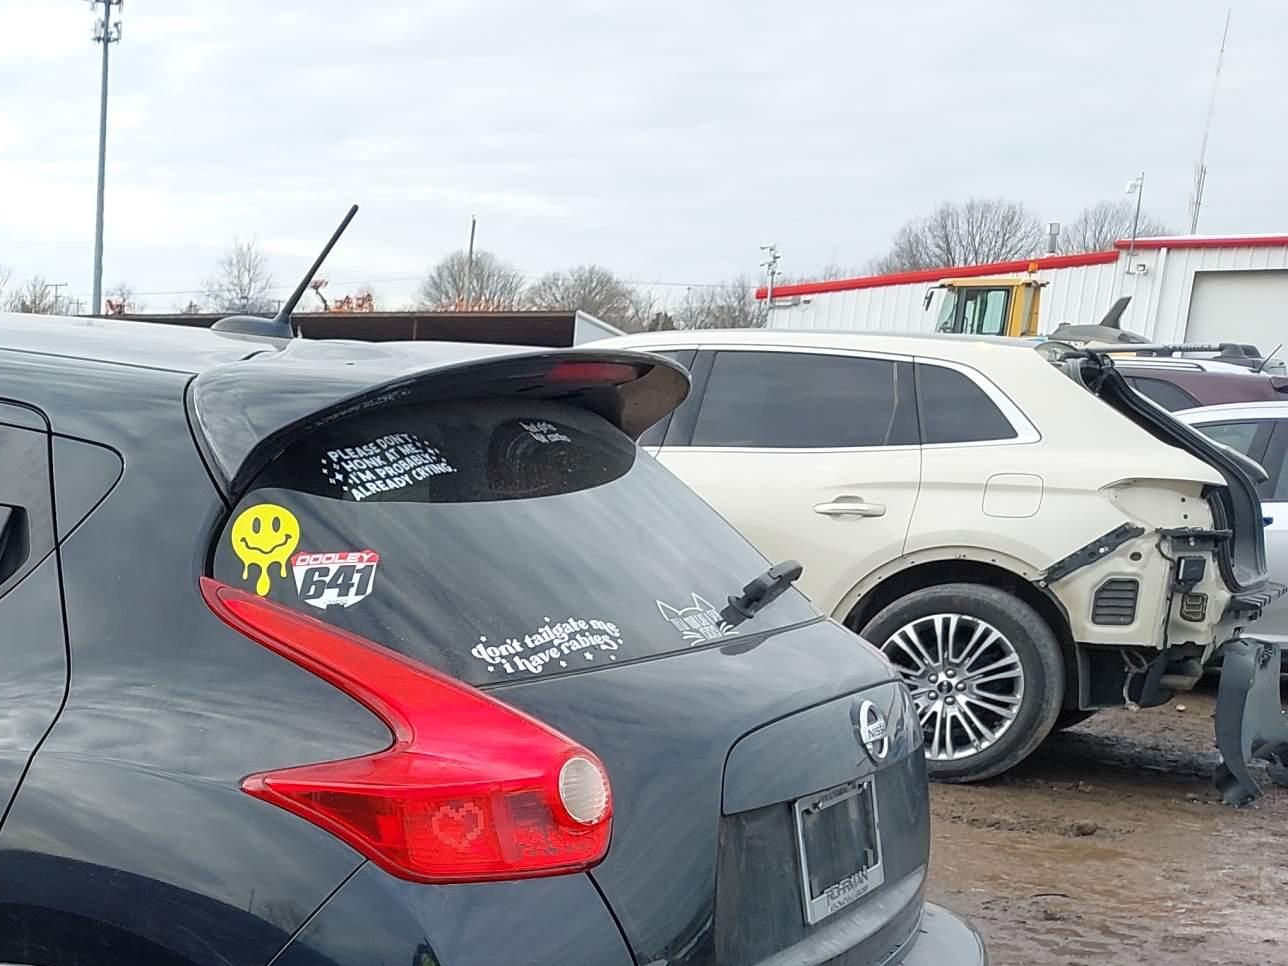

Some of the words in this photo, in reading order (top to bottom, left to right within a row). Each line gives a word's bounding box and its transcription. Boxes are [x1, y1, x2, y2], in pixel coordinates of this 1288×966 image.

[327, 442, 381, 462] PLEASE
[376, 433, 413, 450] DON'T
[340, 455, 387, 472] HONK
[384, 448, 400, 462] AT
[348, 470, 377, 484] I'M
[374, 452, 434, 478] PROBABLY
[351, 474, 414, 501] ALREADY
[296, 552, 373, 566] DOOLEY
[298, 564, 375, 600] 641
[471, 638, 524, 664] don't
[524, 617, 589, 647] tailgate
[589, 619, 620, 637] me
[513, 647, 561, 673] have
[561, 632, 618, 655] rabies
